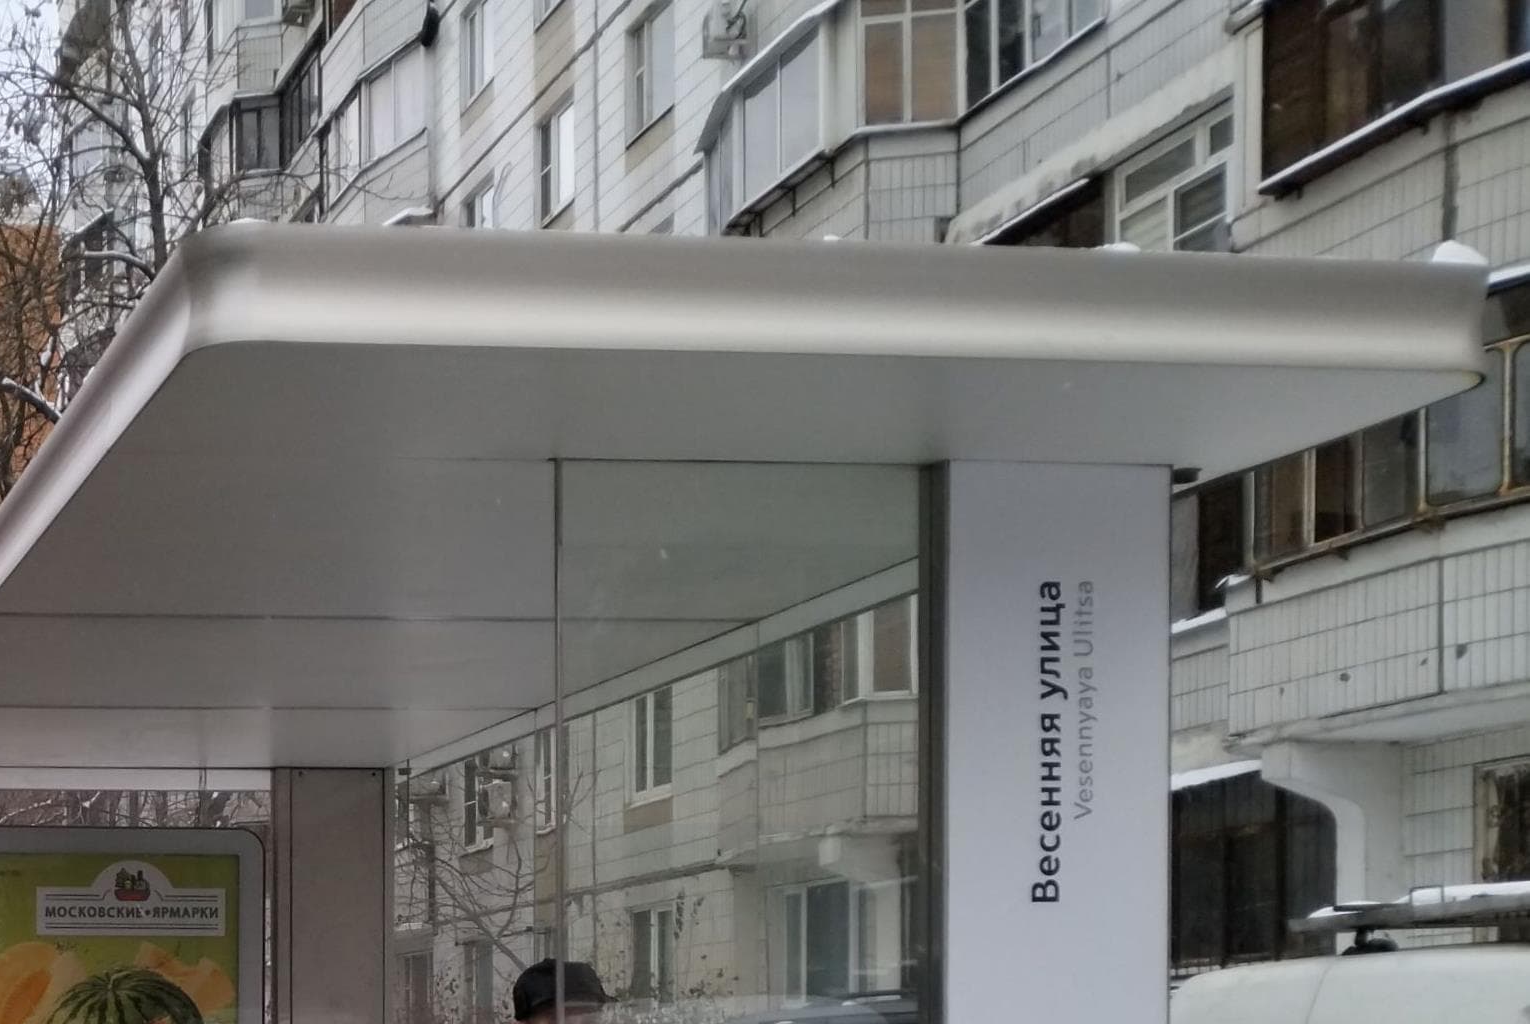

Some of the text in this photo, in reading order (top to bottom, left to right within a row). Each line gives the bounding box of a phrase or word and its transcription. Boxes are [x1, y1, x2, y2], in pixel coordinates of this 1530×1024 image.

[1031, 580, 1069, 903] Весенняя улица
[1072, 579, 1098, 820] Vesennyaya Ulitsa
[44, 905, 219, 919] МОСКОВСКИЕ ЯРМАРКИ
